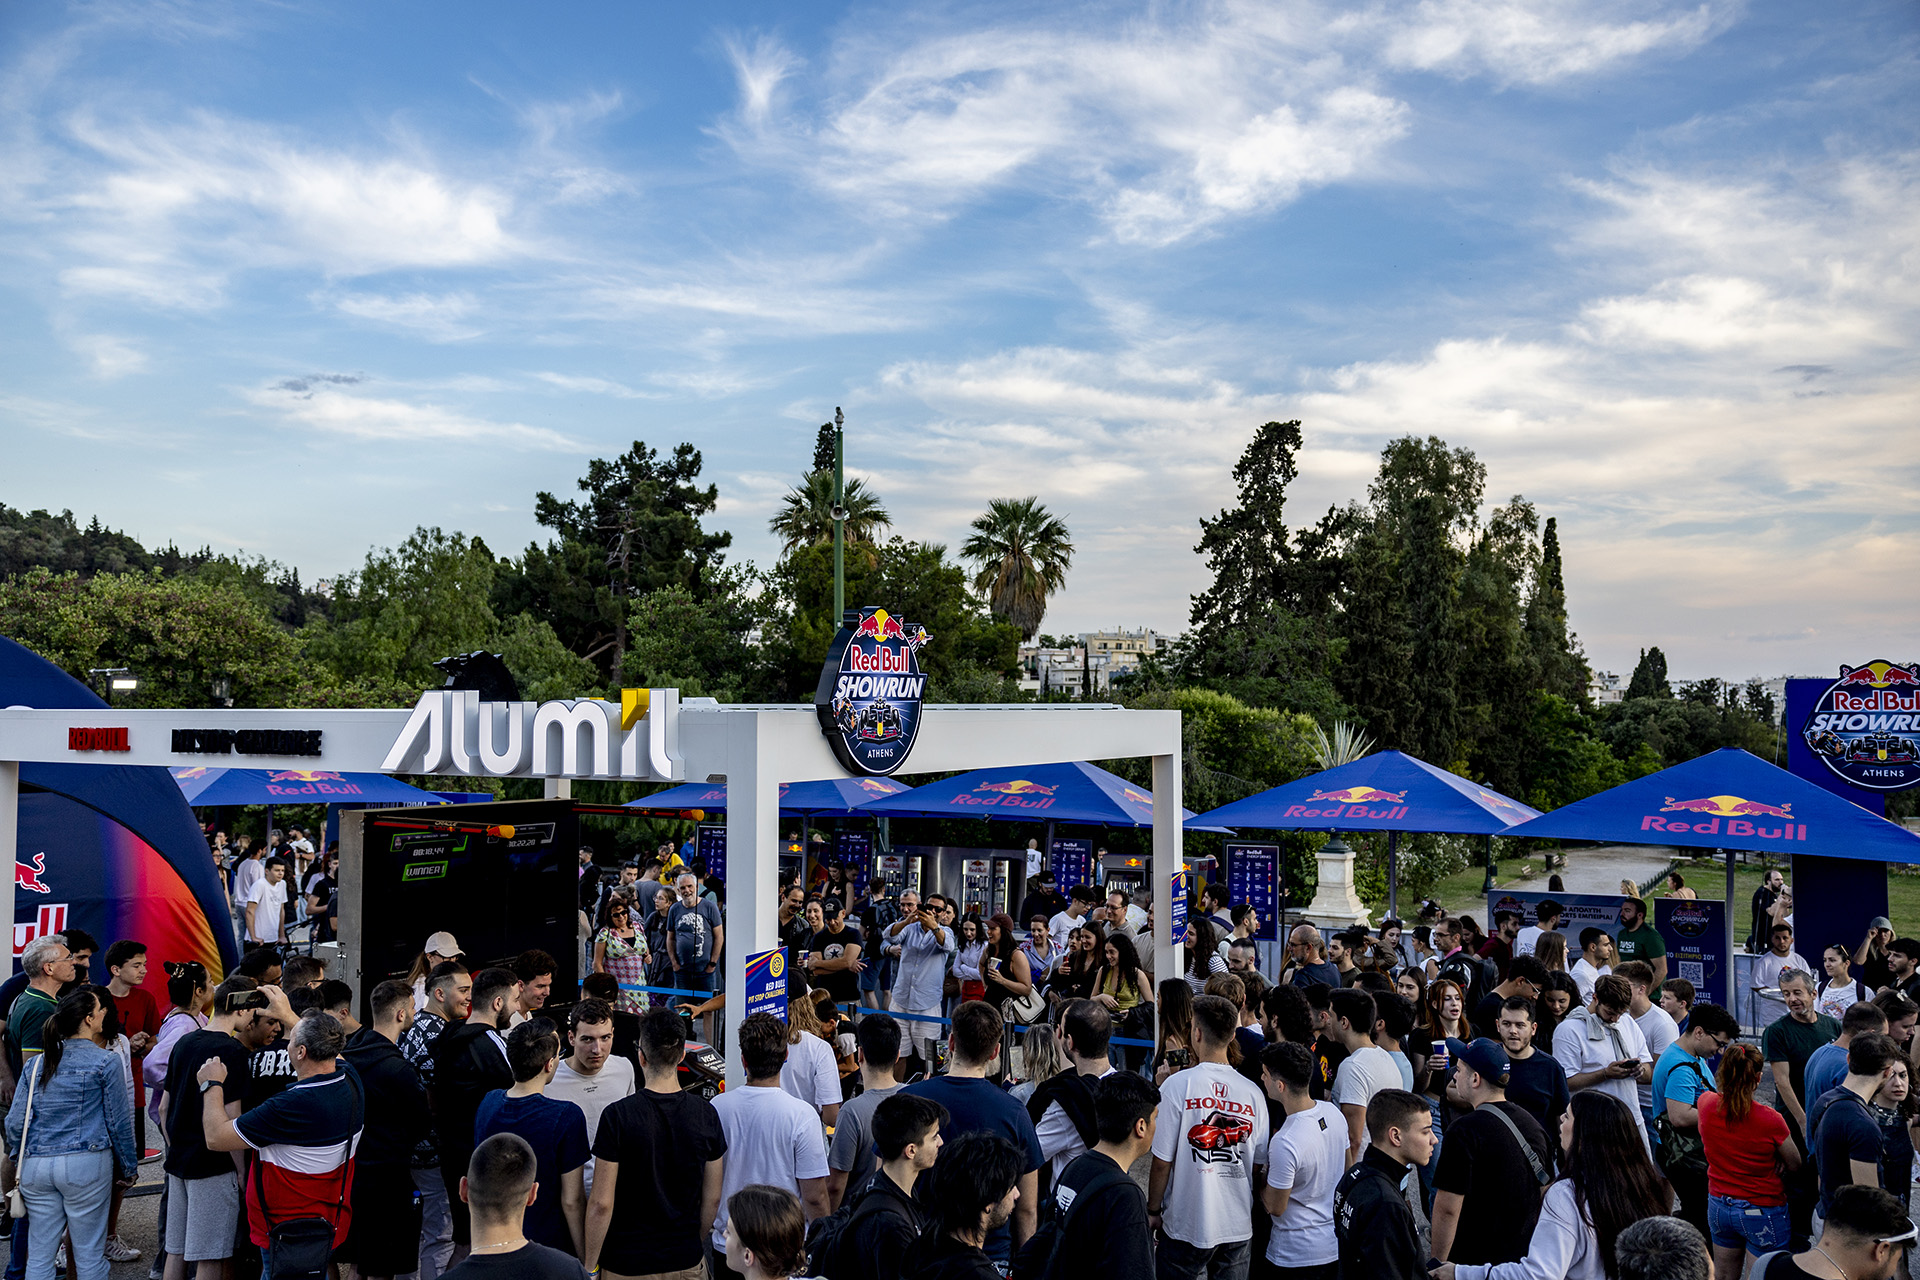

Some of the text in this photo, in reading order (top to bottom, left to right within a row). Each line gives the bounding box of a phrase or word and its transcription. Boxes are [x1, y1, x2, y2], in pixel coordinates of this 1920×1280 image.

[851, 644, 909, 673] Red Bull
[835, 675, 923, 699] SHOWRUN
[1833, 690, 1920, 711] Red Bul
[1811, 714, 1920, 731] SHOWRU
[867, 748, 894, 759] ATHENS
[1862, 769, 1905, 778] ATHENS
[266, 783, 363, 796] Red Bull
[700, 790, 727, 800] Re
[950, 794, 1056, 809] Red Bull
[1283, 804, 1409, 820] Red Bull
[1640, 815, 1807, 841] Red Bull
[13, 904, 68, 957] ull
[700, 1054, 717, 1063] VISA
[702, 1087, 715, 1096] FIA
[1185, 1097, 1256, 1117] HONDA
